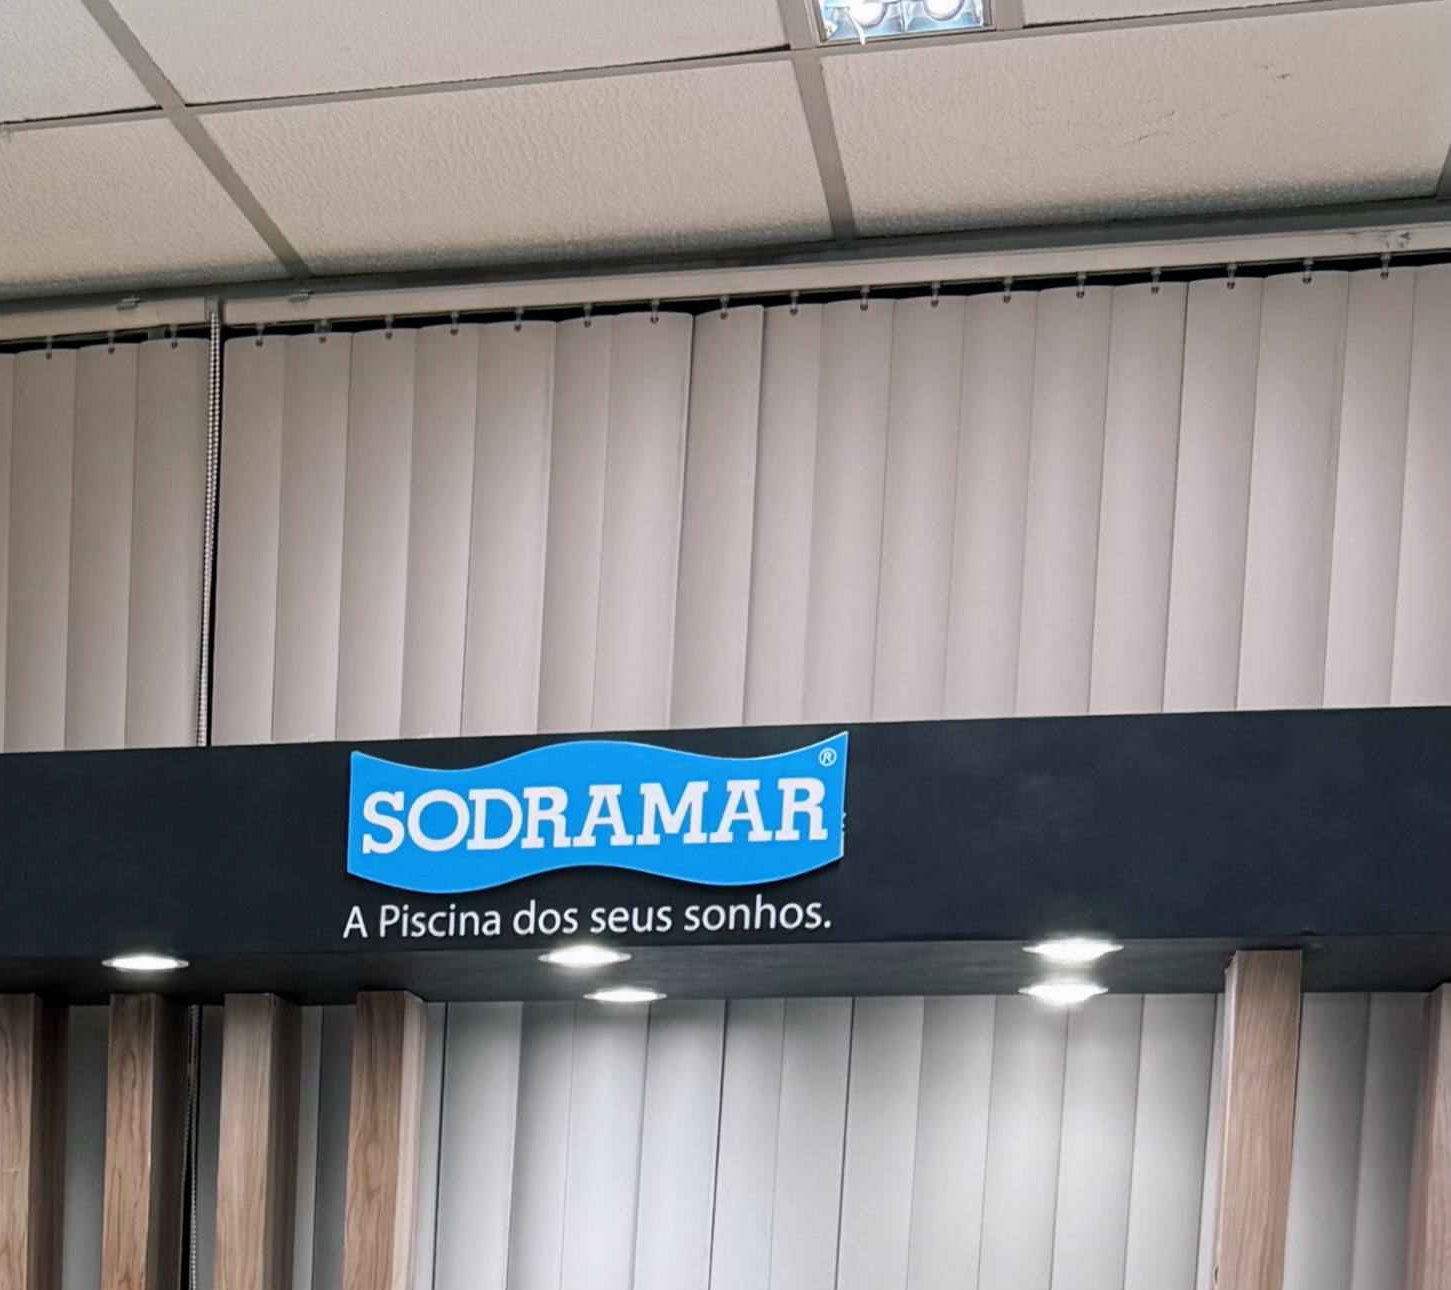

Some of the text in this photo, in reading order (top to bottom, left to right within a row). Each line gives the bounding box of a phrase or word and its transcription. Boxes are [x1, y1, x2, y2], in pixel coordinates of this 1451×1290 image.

[362, 777, 828, 855] SODRAMAR
[343, 894, 832, 939] A Piscina dos seus sonhos.
